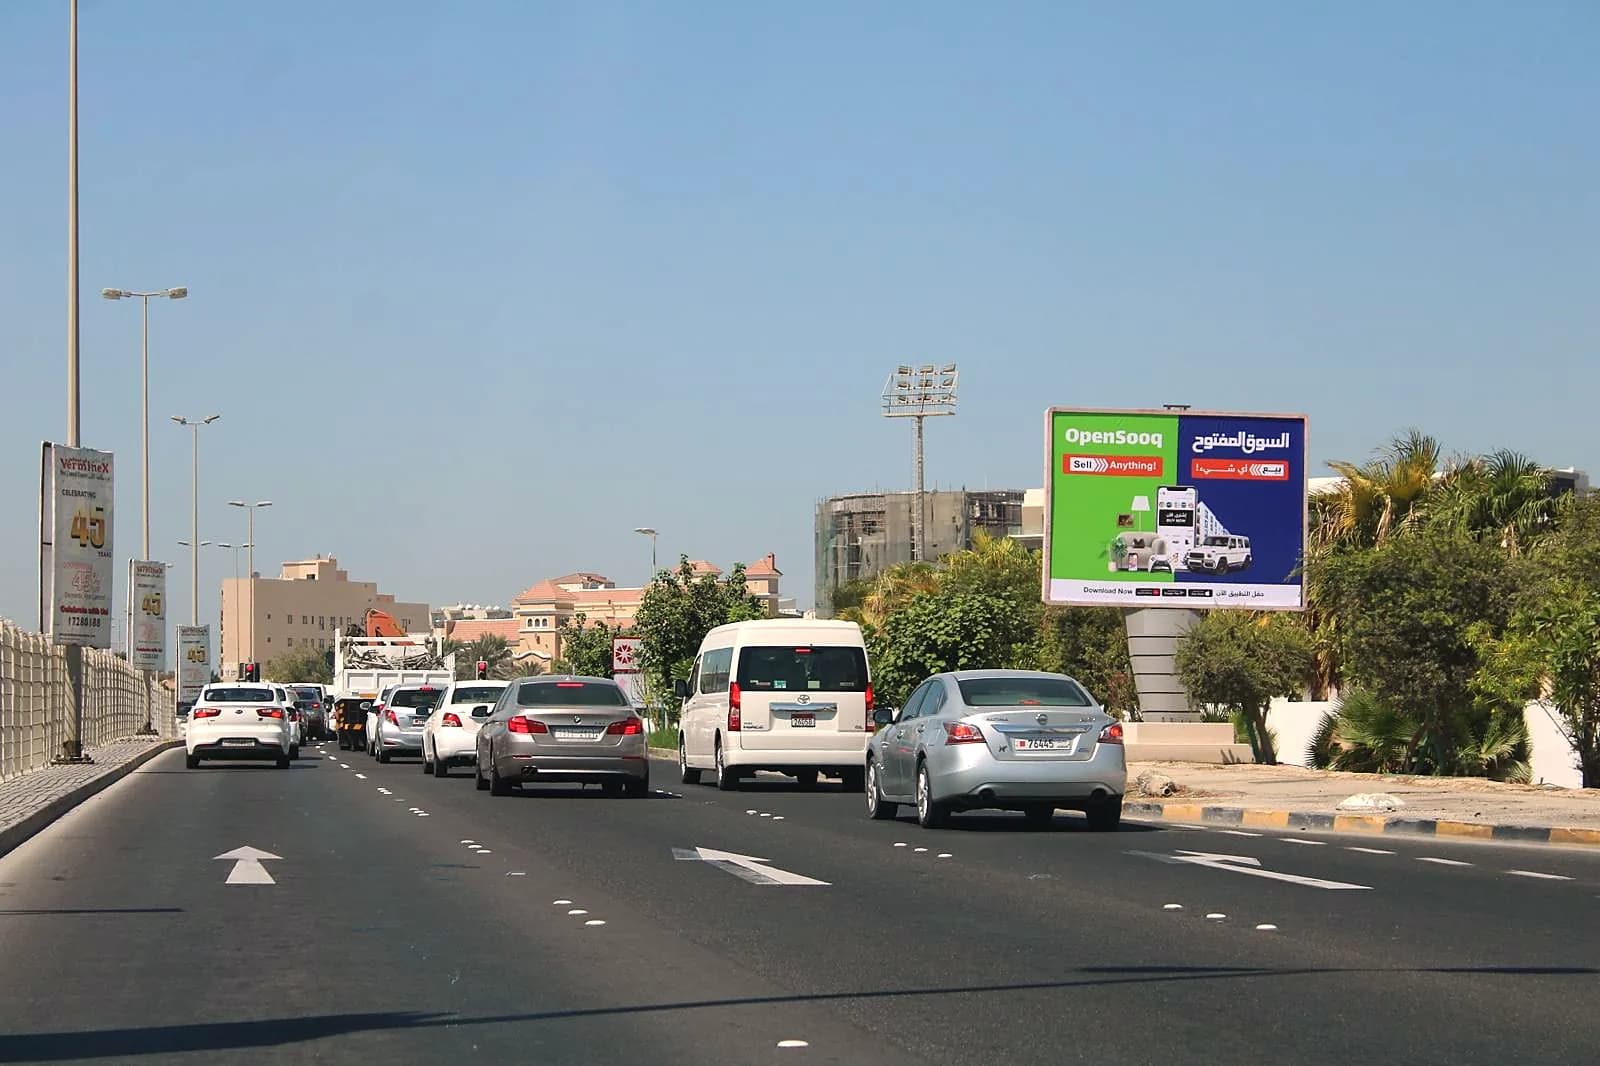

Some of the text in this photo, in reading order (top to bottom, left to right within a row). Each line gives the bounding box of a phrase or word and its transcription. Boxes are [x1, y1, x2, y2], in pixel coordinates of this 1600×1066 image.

[1065, 428, 1163, 448] OpenSooq
[1073, 460, 1157, 471] Sell Anything!
[71, 504, 105, 549] 45
[1083, 586, 1117, 595] Download
[1118, 587, 1133, 595] Now
[1028, 738, 1054, 749] 76445
